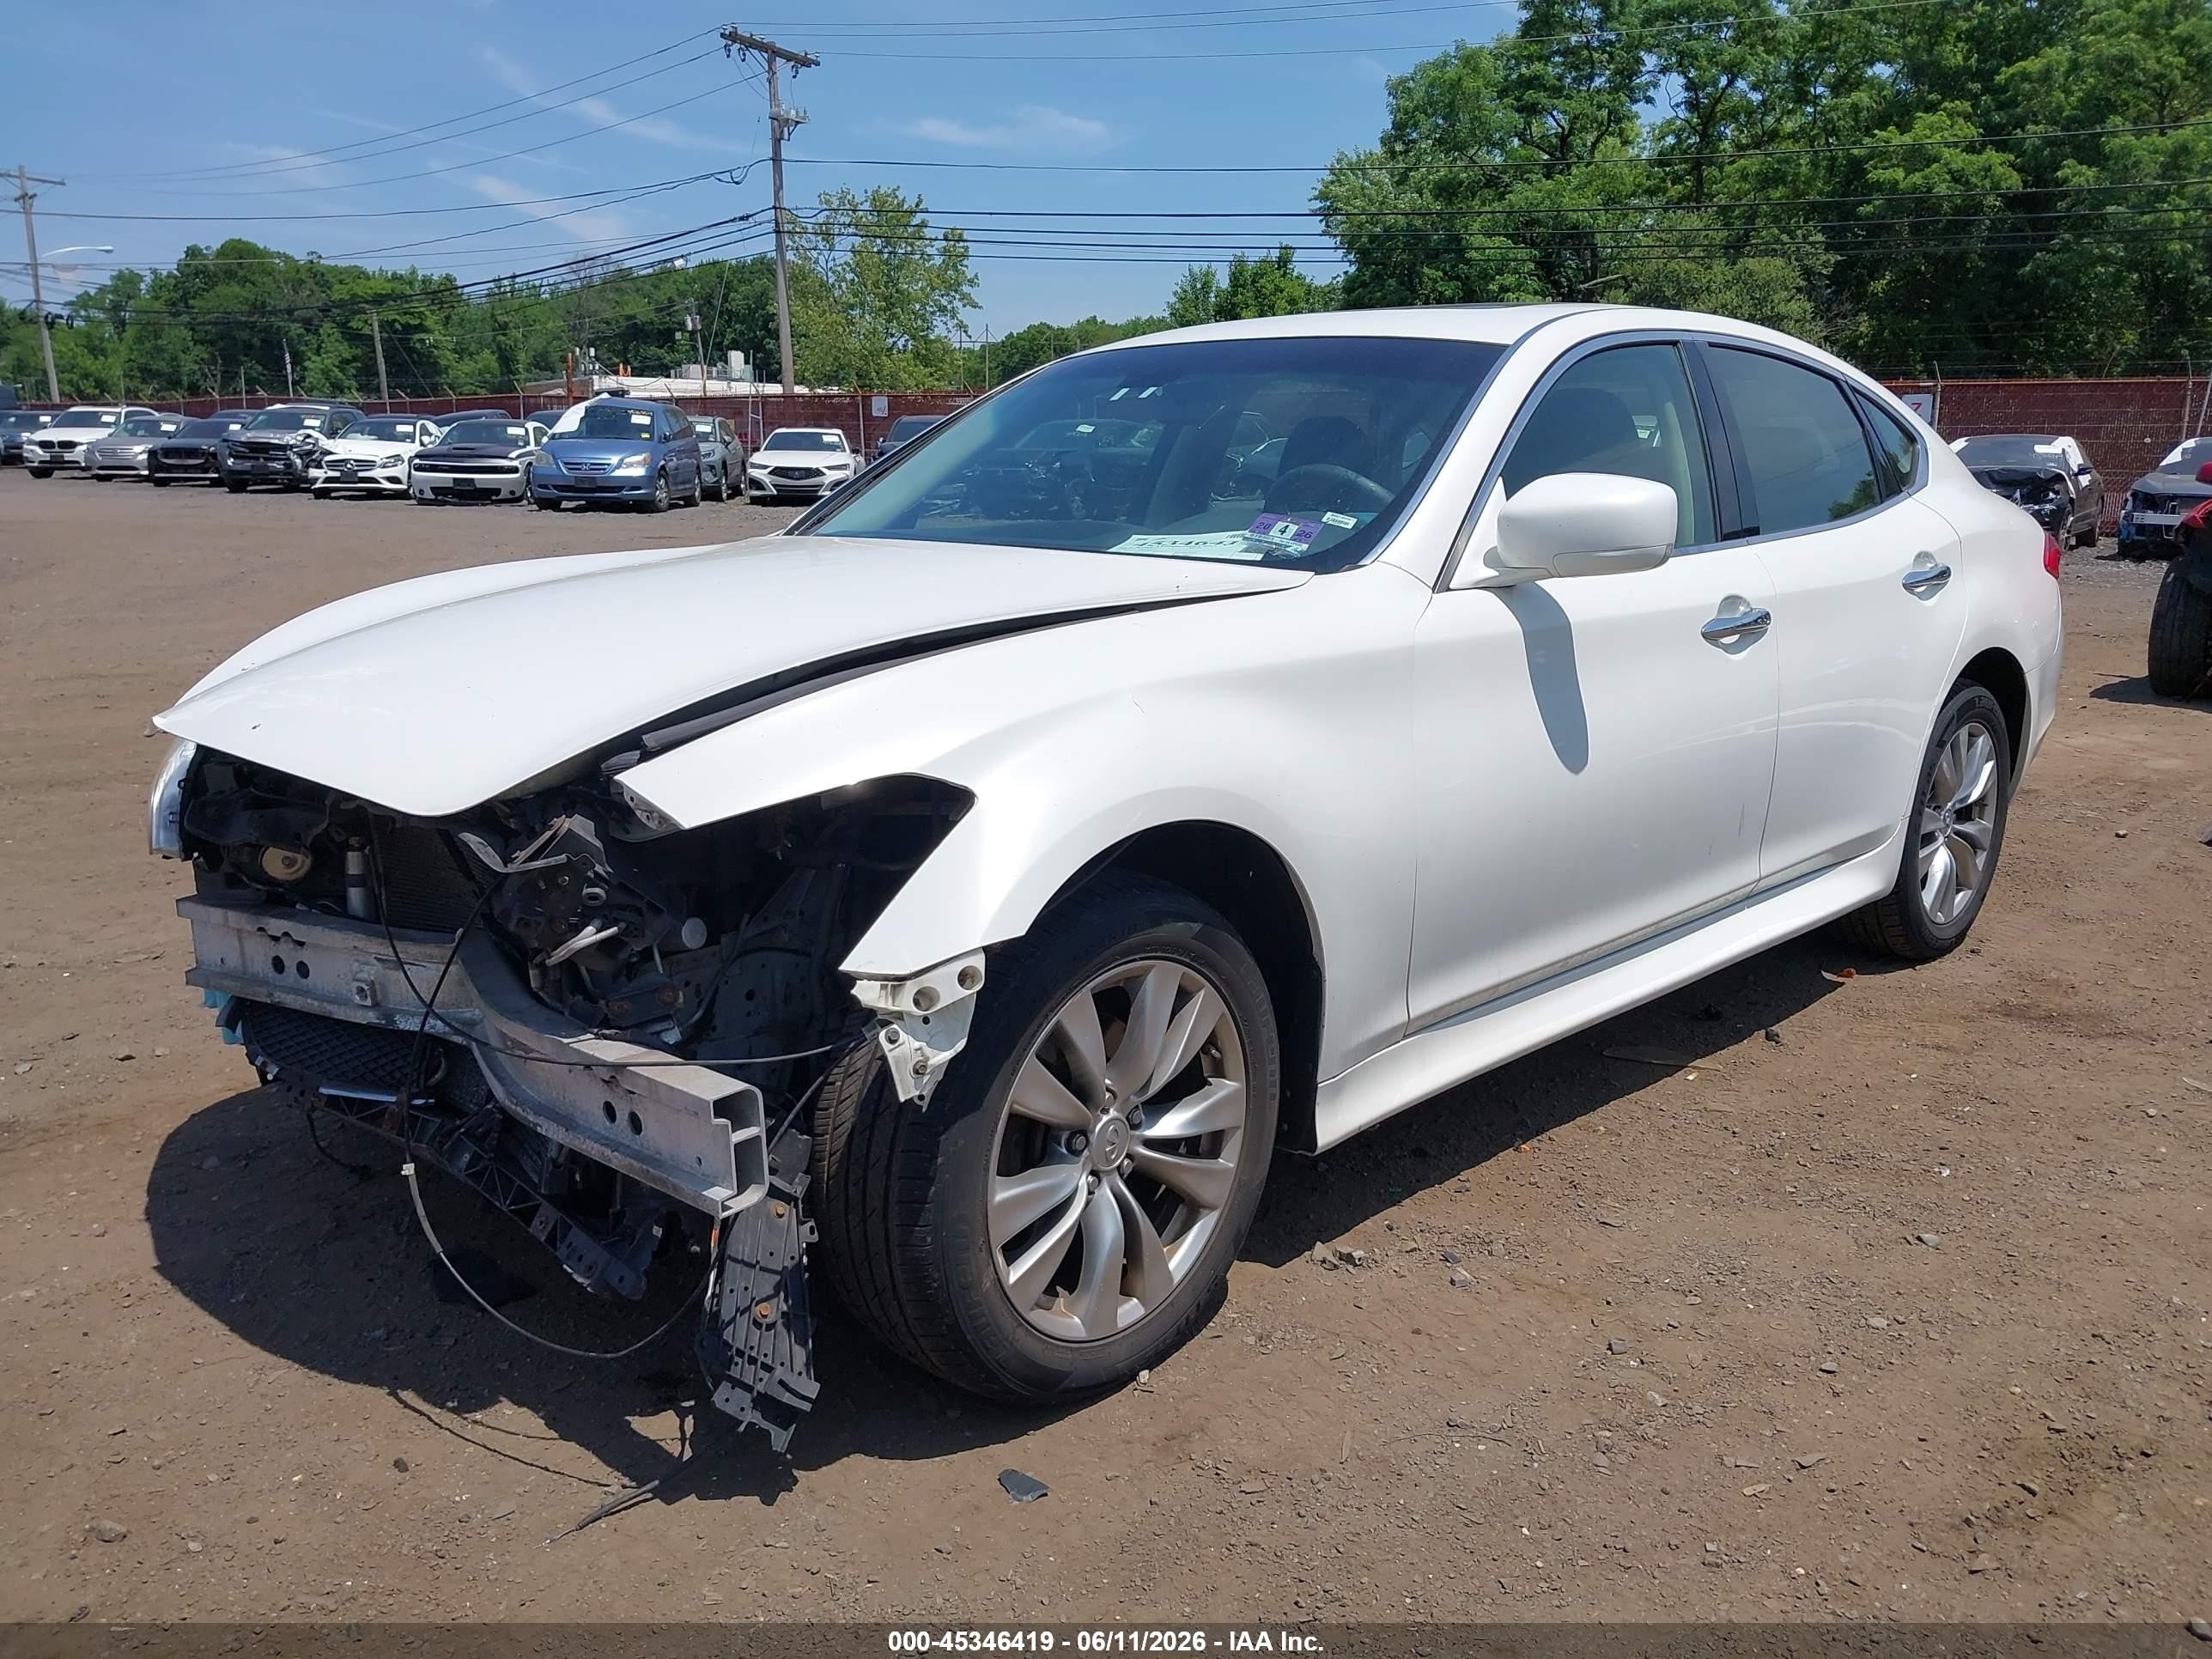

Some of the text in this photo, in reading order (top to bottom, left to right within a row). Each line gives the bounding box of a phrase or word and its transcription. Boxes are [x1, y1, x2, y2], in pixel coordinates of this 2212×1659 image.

[1255, 521, 1314, 539] 20 4 26
